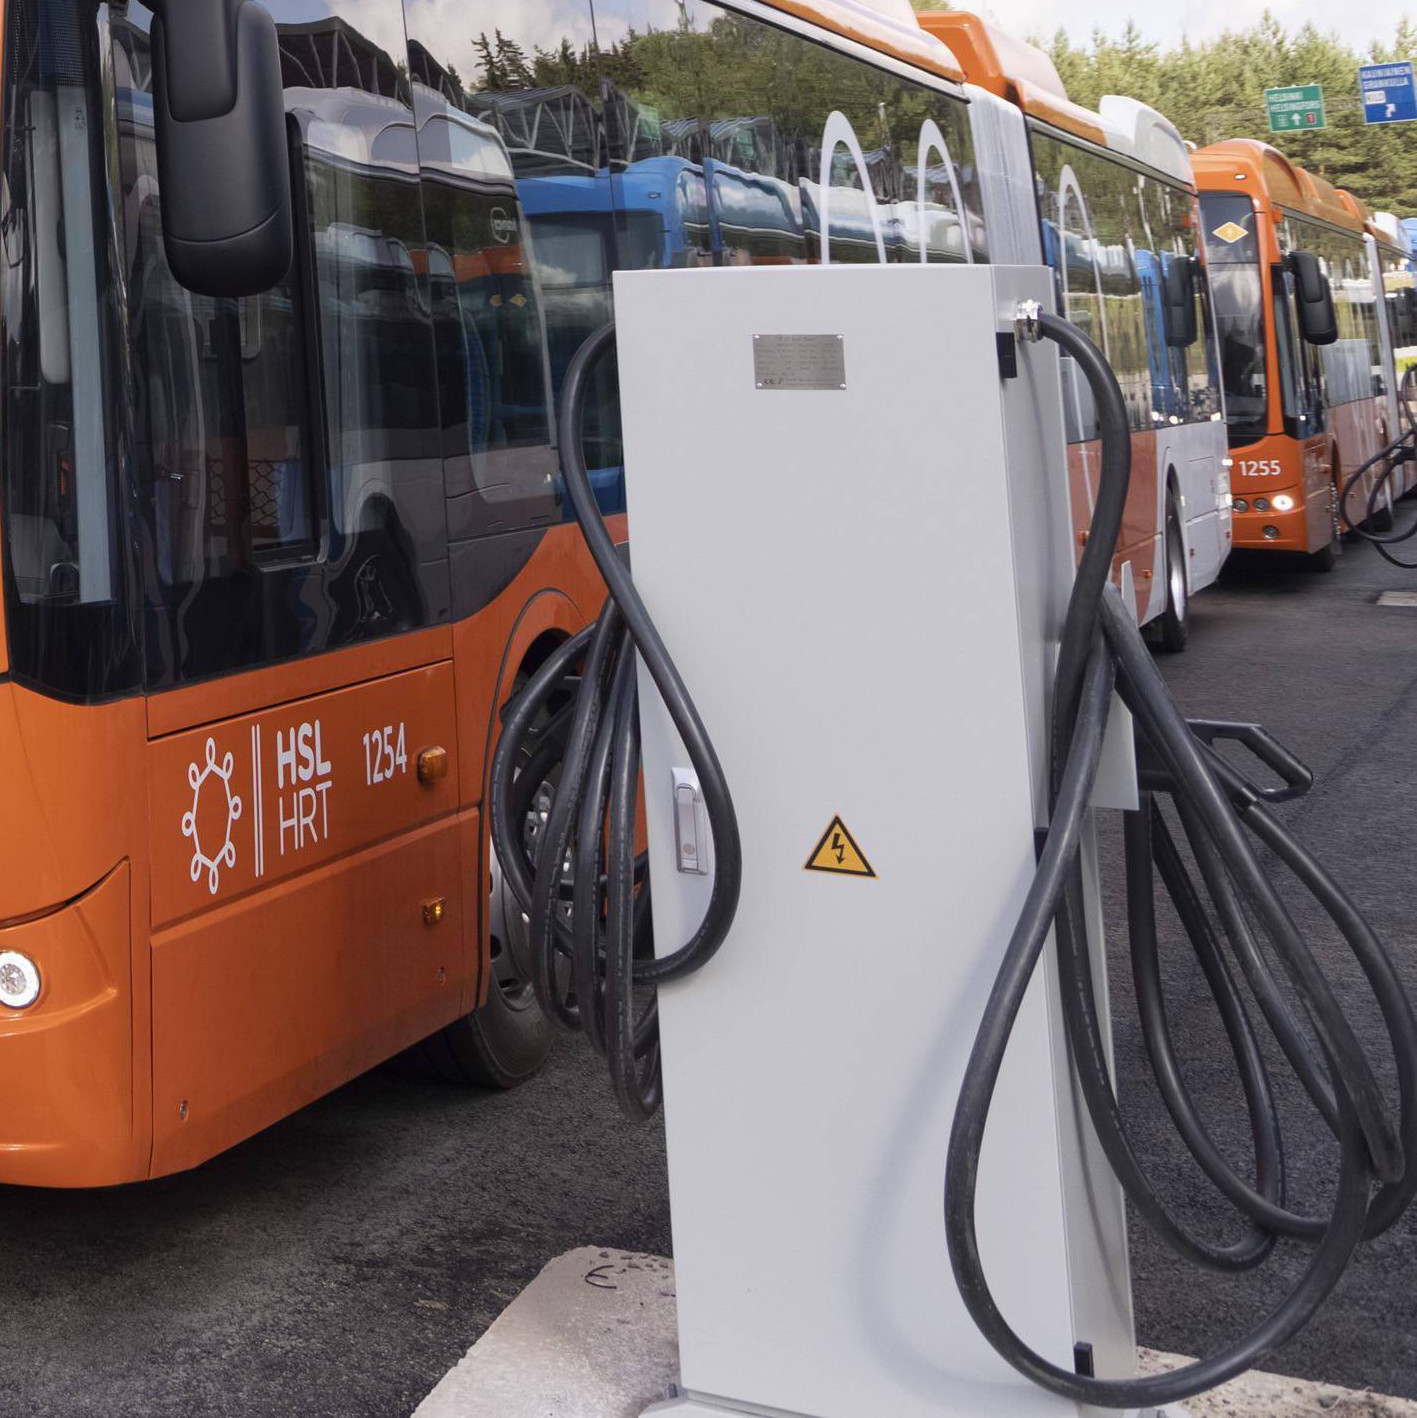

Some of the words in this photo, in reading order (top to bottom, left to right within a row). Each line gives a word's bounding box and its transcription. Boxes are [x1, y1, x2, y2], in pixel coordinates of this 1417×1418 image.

[1238, 460, 1281, 476] 1255
[276, 719, 332, 789] HSL
[363, 722, 407, 786] 1254
[278, 780, 333, 855] HRT
